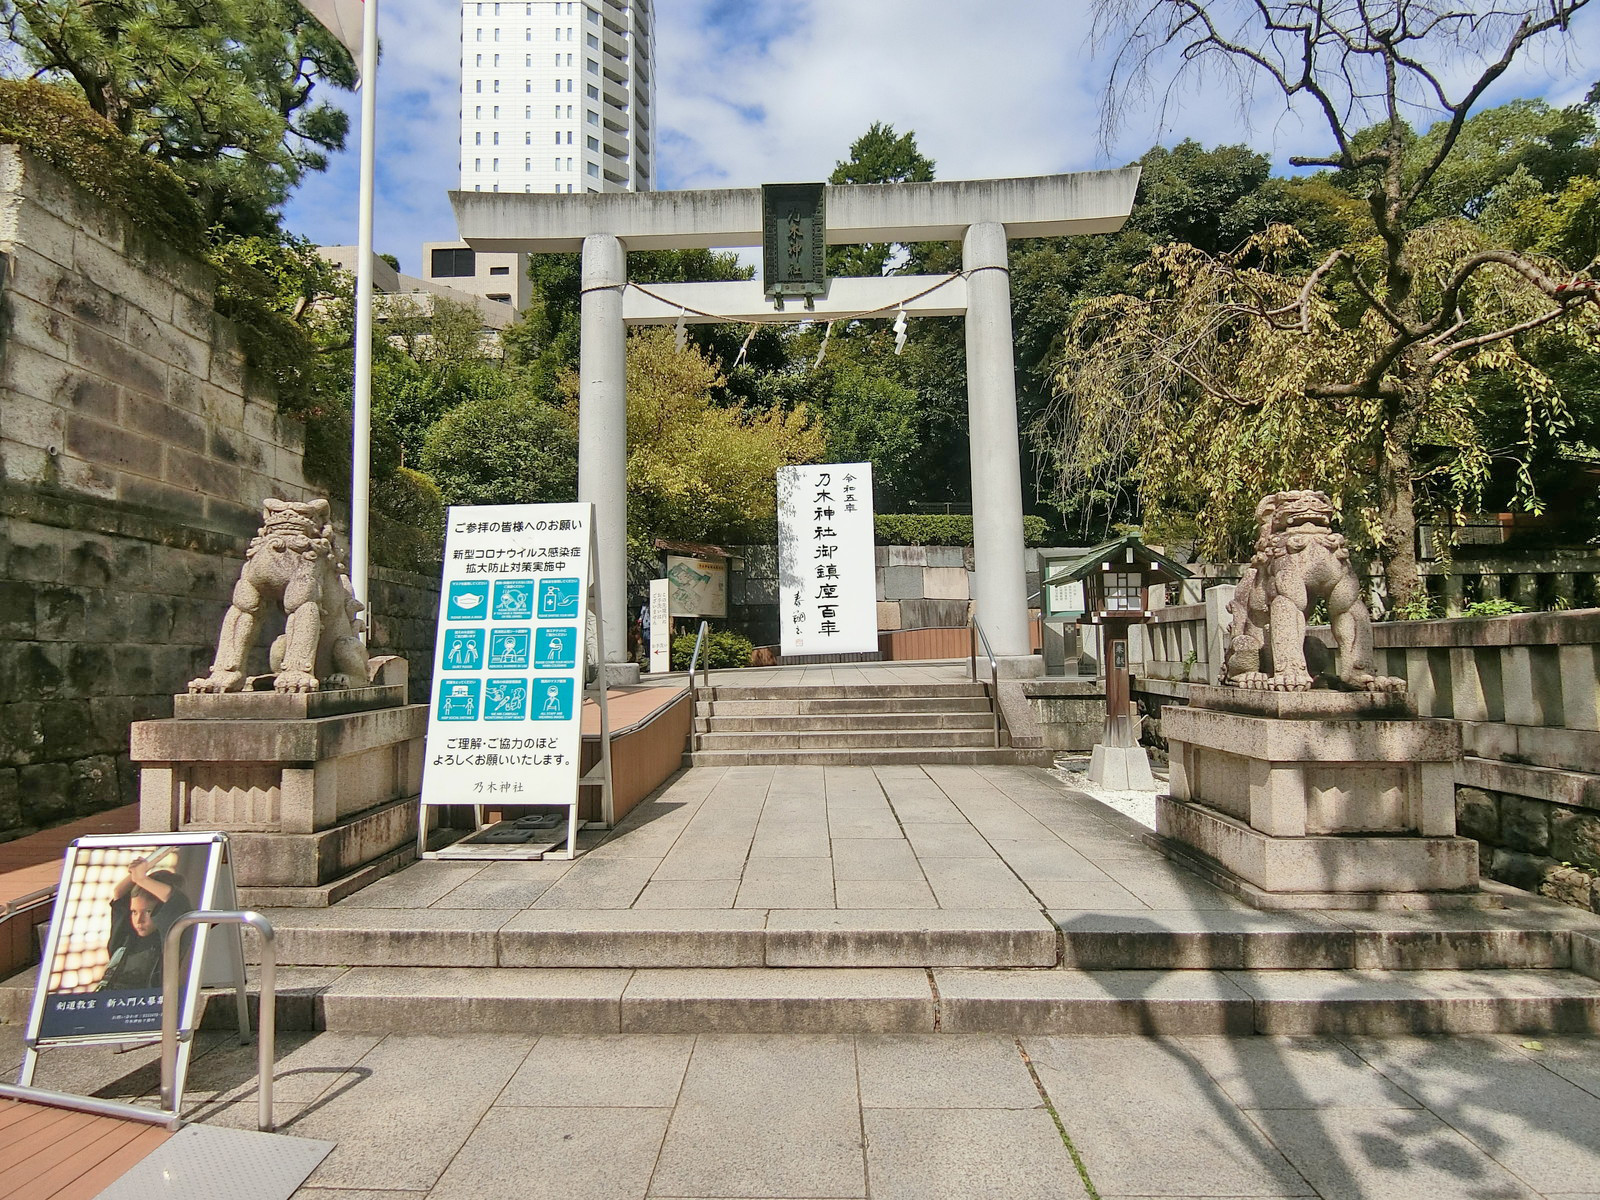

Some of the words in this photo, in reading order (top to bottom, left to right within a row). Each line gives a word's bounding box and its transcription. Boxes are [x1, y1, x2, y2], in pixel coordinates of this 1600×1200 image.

[842, 473, 858, 513] 令和五年
[454, 519, 582, 533] ご参拝の皆様へのお願い
[452, 546, 581, 560] 新型コロナウイルス感染症
[813, 472, 841, 637] 乃木神社御鎮座百年
[465, 561, 566, 574] 拡大防止対策実施中
[433, 753, 570, 766] よろしくお願いいたします。
[473, 781, 524, 793] 乃木神社
